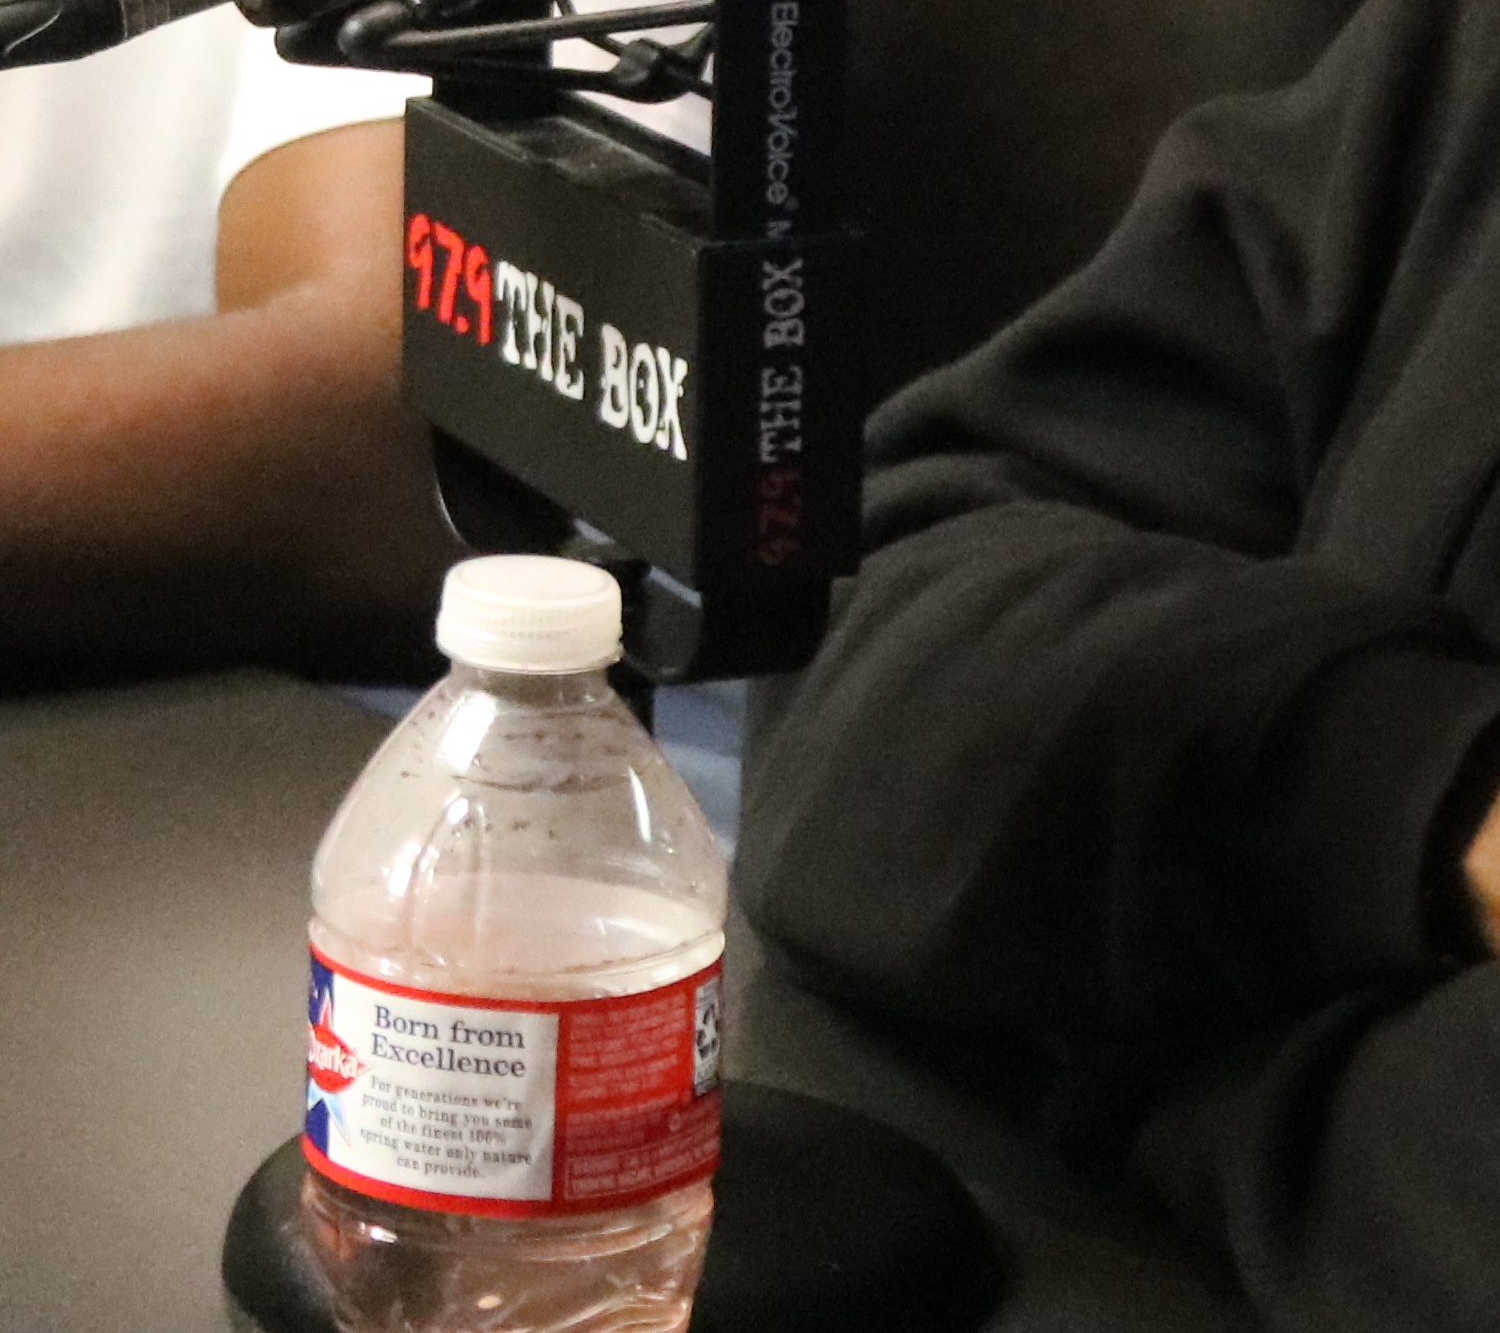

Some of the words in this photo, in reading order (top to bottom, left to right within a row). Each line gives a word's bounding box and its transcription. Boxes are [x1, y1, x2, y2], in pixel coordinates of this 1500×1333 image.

[761, 258, 804, 348] BOX
[408, 212, 492, 345] 97.9
[496, 260, 584, 400] THE
[600, 323, 688, 461] BOX
[760, 365, 802, 463] THE
[375, 1004, 438, 1040] Born
[450, 1020, 525, 1049] from
[371, 1033, 526, 1078] Excellence
[362, 1093, 397, 1113] proud
[402, 1103, 415, 1116] to
[419, 1105, 458, 1127] bring
[464, 1114, 489, 1129] you
[371, 1076, 392, 1093] For
[396, 1085, 479, 1108] generations
[361, 1128, 398, 1150] spring
[404, 1139, 441, 1156] water
[446, 1146, 476, 1165] only
[380, 1116, 392, 1128] of
[396, 1119, 418, 1134] the
[422, 1124, 463, 1142] finest
[397, 1156, 420, 1170] can
